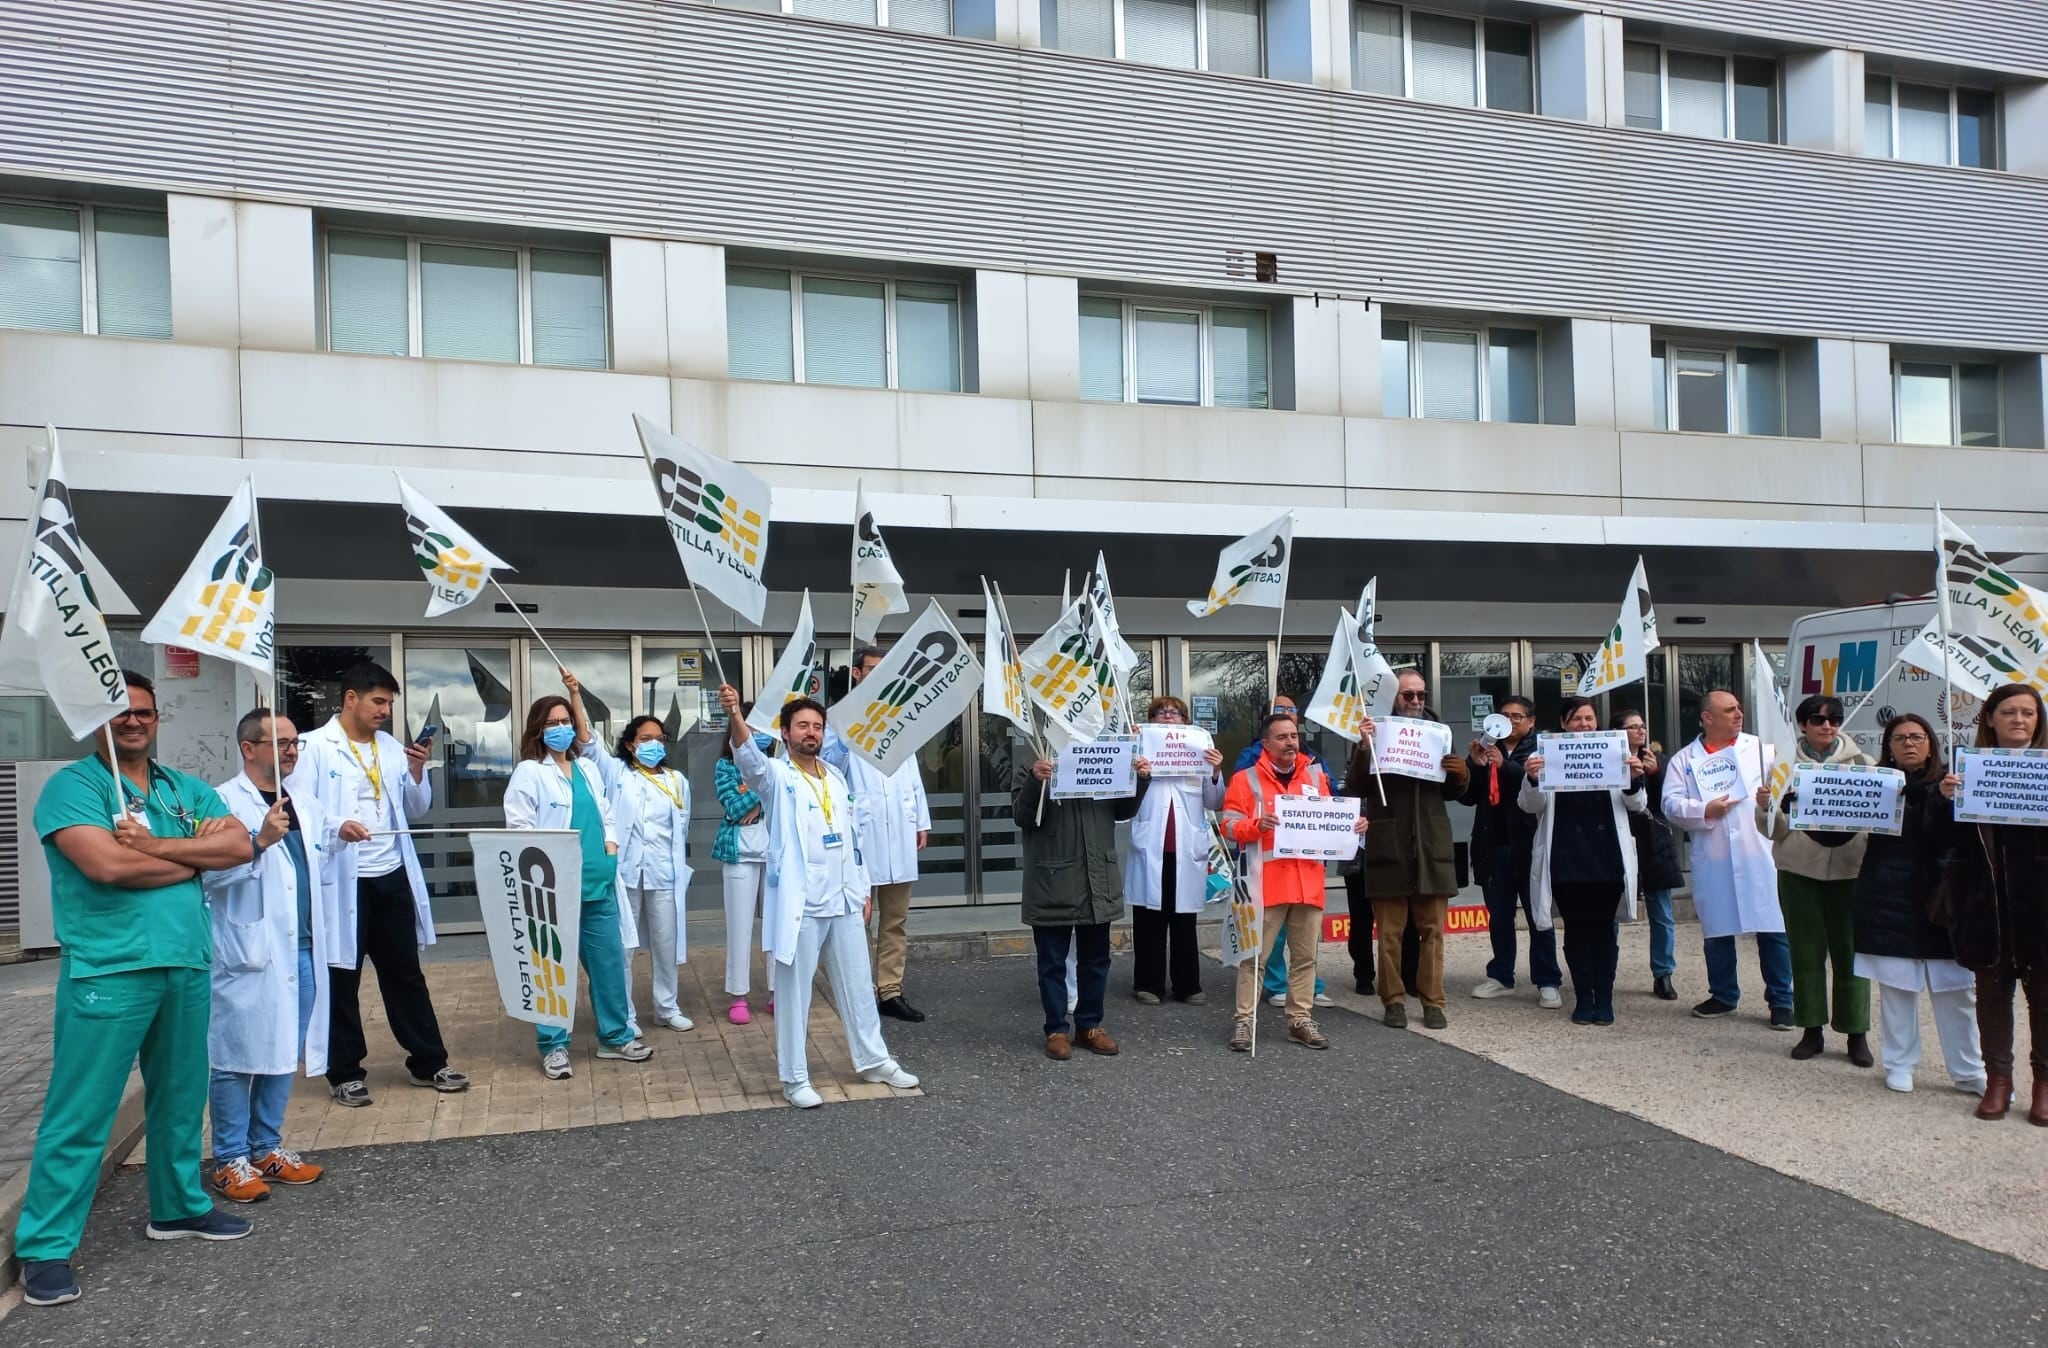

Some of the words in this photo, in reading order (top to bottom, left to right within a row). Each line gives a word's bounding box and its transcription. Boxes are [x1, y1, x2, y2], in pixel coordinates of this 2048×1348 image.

[2003, 614, 2044, 654] LEÓN
[81, 640, 125, 703] LEÓN
[1399, 728, 1423, 737] A1+
[1398, 739, 1421, 748] NIVEL
[1558, 742, 1608, 750] ESTATUTO
[1072, 746, 1120, 754] ESTATUTO
[1387, 747, 1430, 759] ESPECÍFICO
[1078, 757, 1113, 765] PROPIO
[1076, 767, 1101, 775] PARA
[1103, 767, 1114, 775] EL
[1565, 771, 1603, 779] MÉDICO
[1076, 776, 1112, 785] MÉDICO
[1812, 776, 1883, 788] JUBILACIÓN
[1977, 780, 1998, 788] POR
[1815, 788, 1863, 798] BASADA
[1812, 798, 1825, 806] EL
[1828, 799, 1870, 808] RIESGO
[1282, 809, 1322, 818] ESTATUTO
[1324, 811, 1355, 820] PROPIO
[1804, 808, 1819, 816] LA
[1821, 809, 1889, 820] PENOSIDAD
[1284, 822, 1306, 830] PARA
[1307, 823, 1318, 831] EL
[1318, 823, 1351, 832] MÉDICO
[1447, 909, 1490, 929] UMA
[499, 850, 525, 940] CASTILLA
[513, 945, 525, 955] y
[519, 960, 533, 1011] LEÓN
